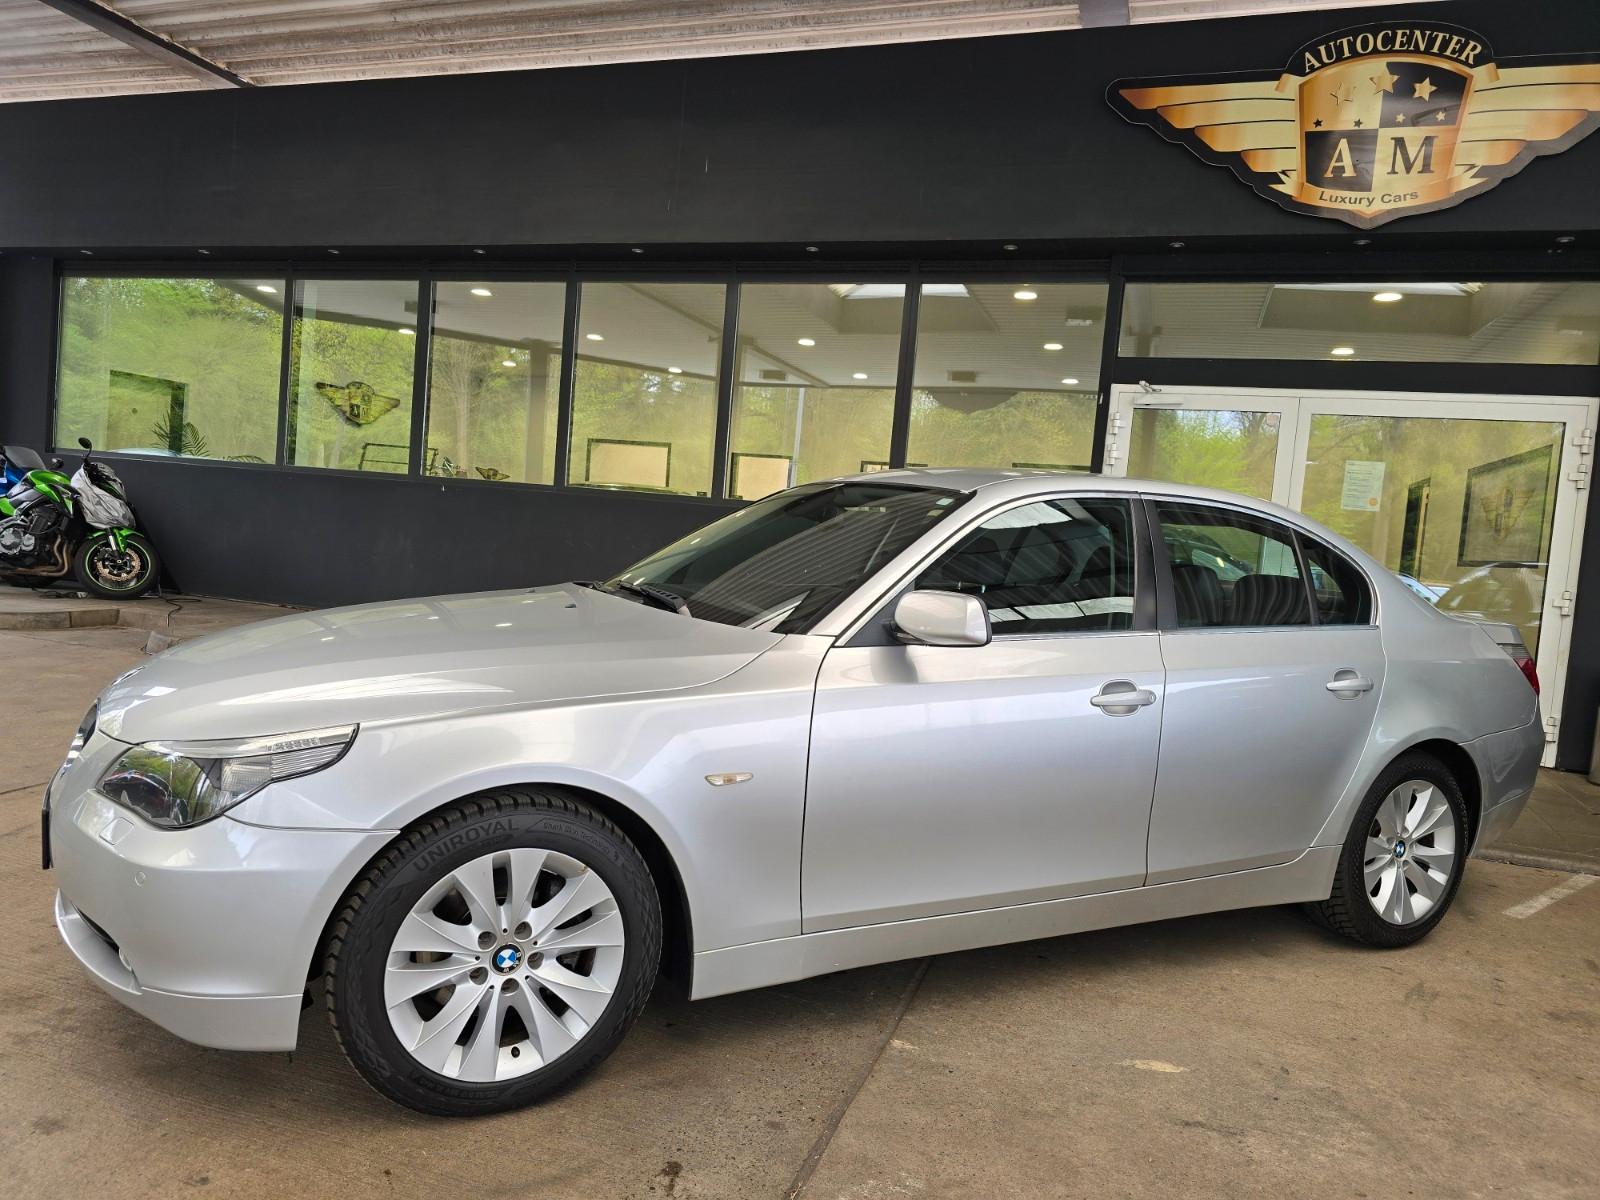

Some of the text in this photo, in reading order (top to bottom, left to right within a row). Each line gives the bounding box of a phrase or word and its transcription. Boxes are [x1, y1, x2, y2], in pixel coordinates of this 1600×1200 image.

[1303, 29, 1483, 73] AUTOCENTER
[1323, 134, 1439, 178] A M
[1318, 188, 1420, 208] Luxury Cars
[413, 818, 520, 871] UNIROYAL
